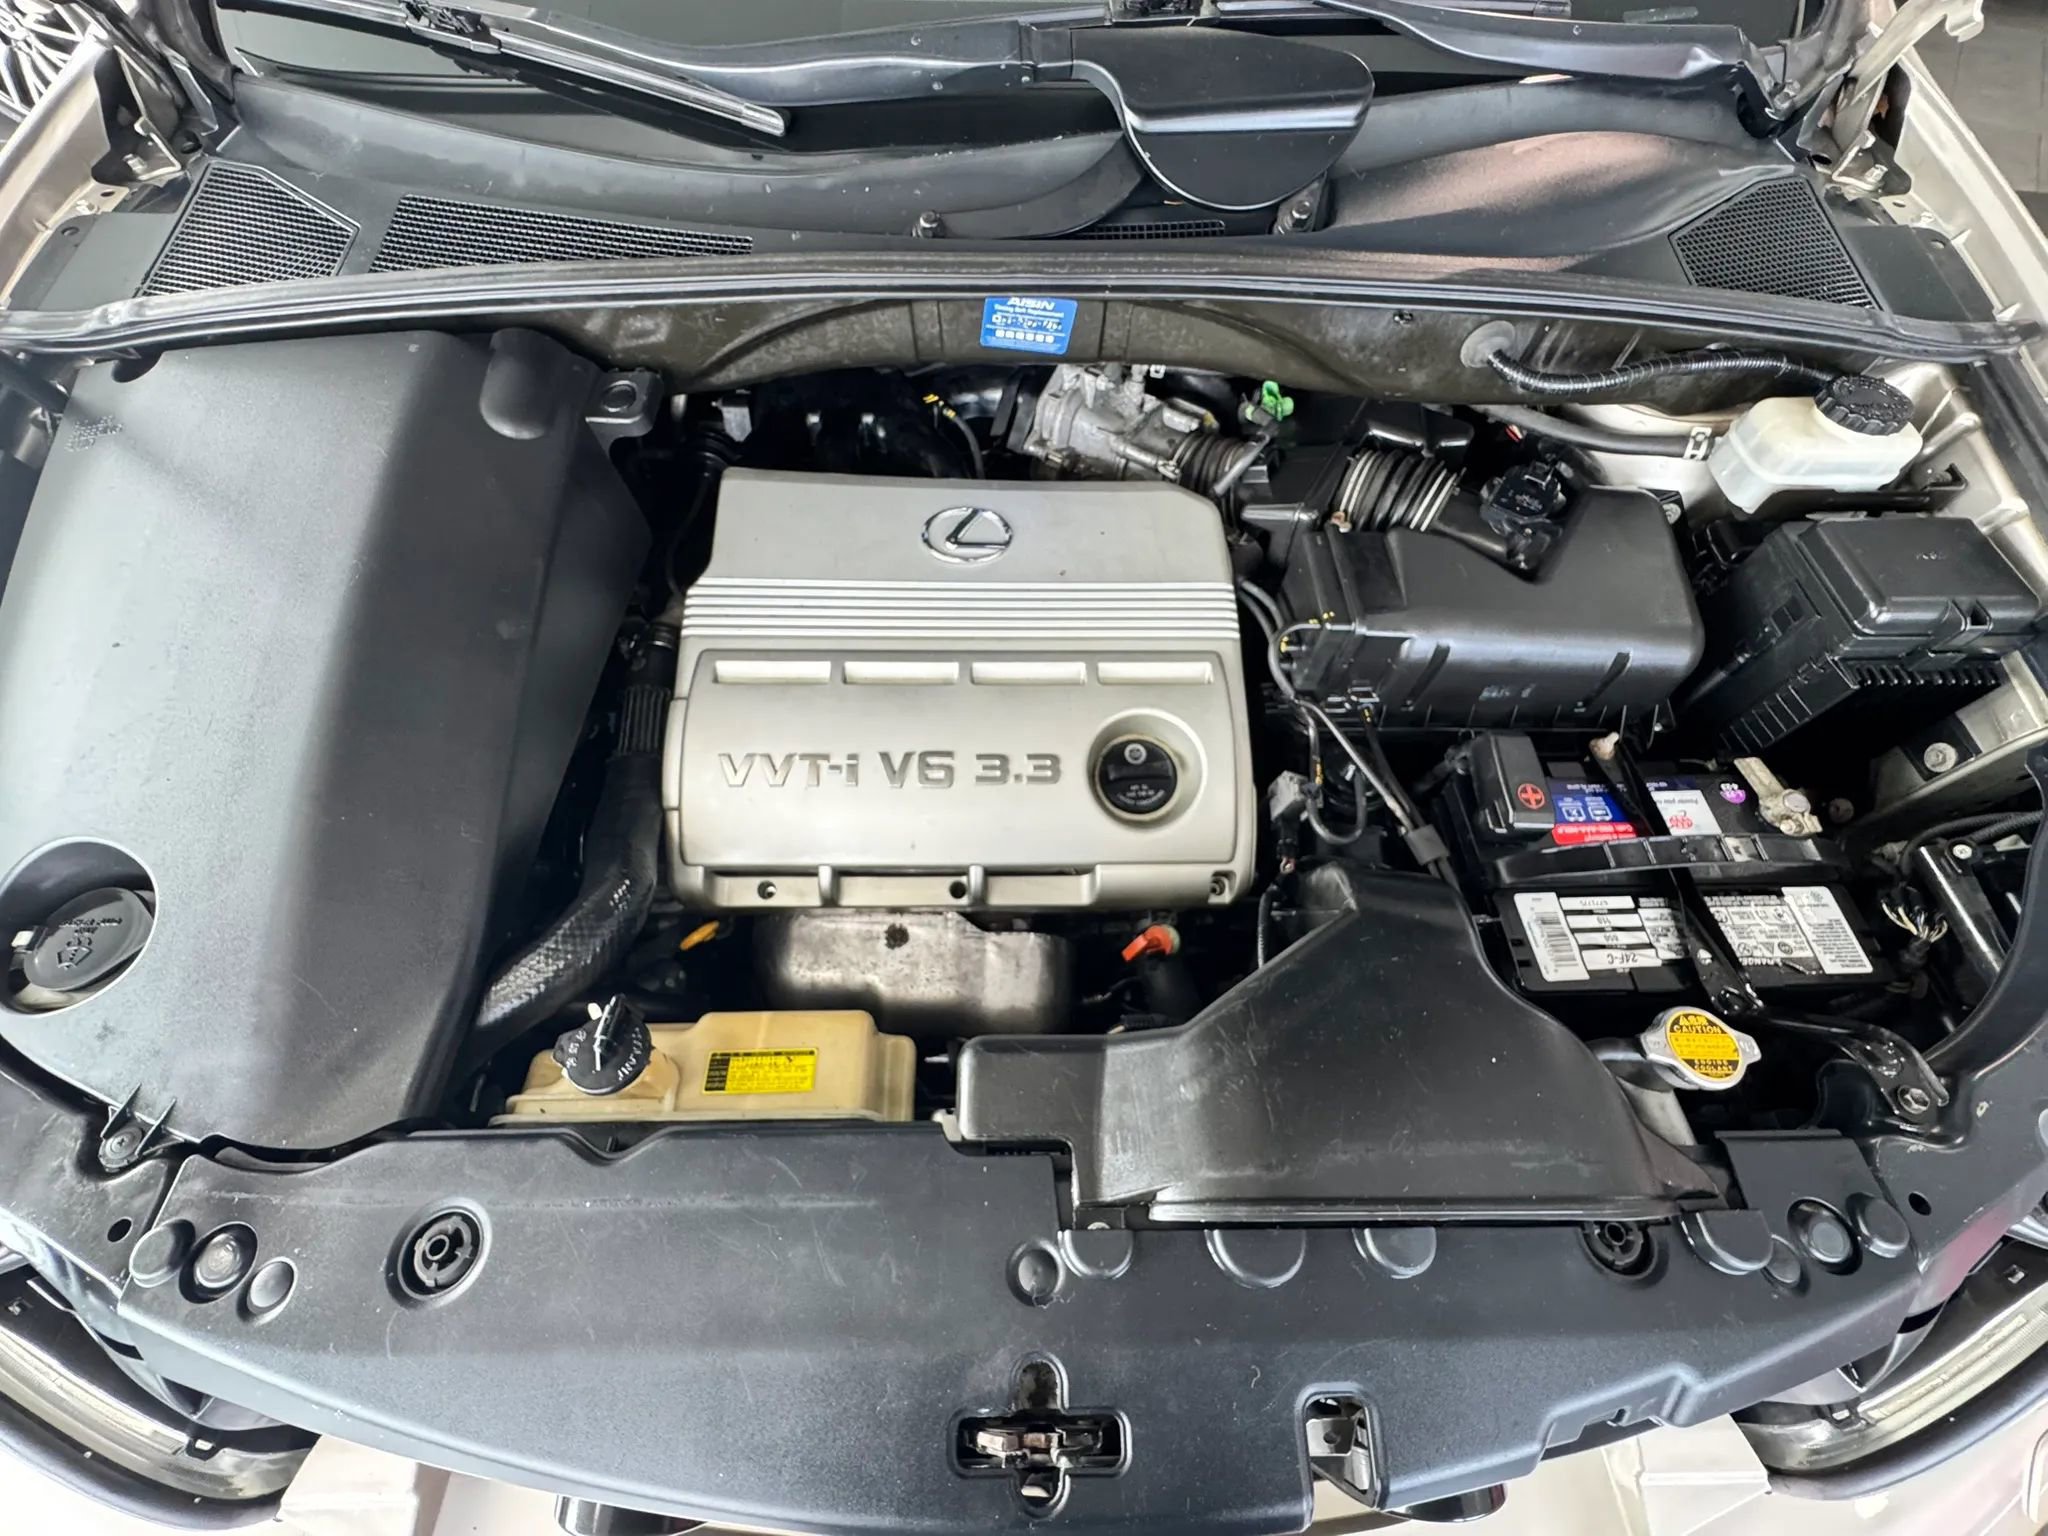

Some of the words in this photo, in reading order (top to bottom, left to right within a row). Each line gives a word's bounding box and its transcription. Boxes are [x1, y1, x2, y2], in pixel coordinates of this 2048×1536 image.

[1006, 297, 1055, 310] AISIN
[718, 752, 858, 787] VVT-i
[879, 751, 954, 788] V6
[975, 753, 1061, 784] 3.3
[1673, 1024, 1721, 1034] CAUTION
